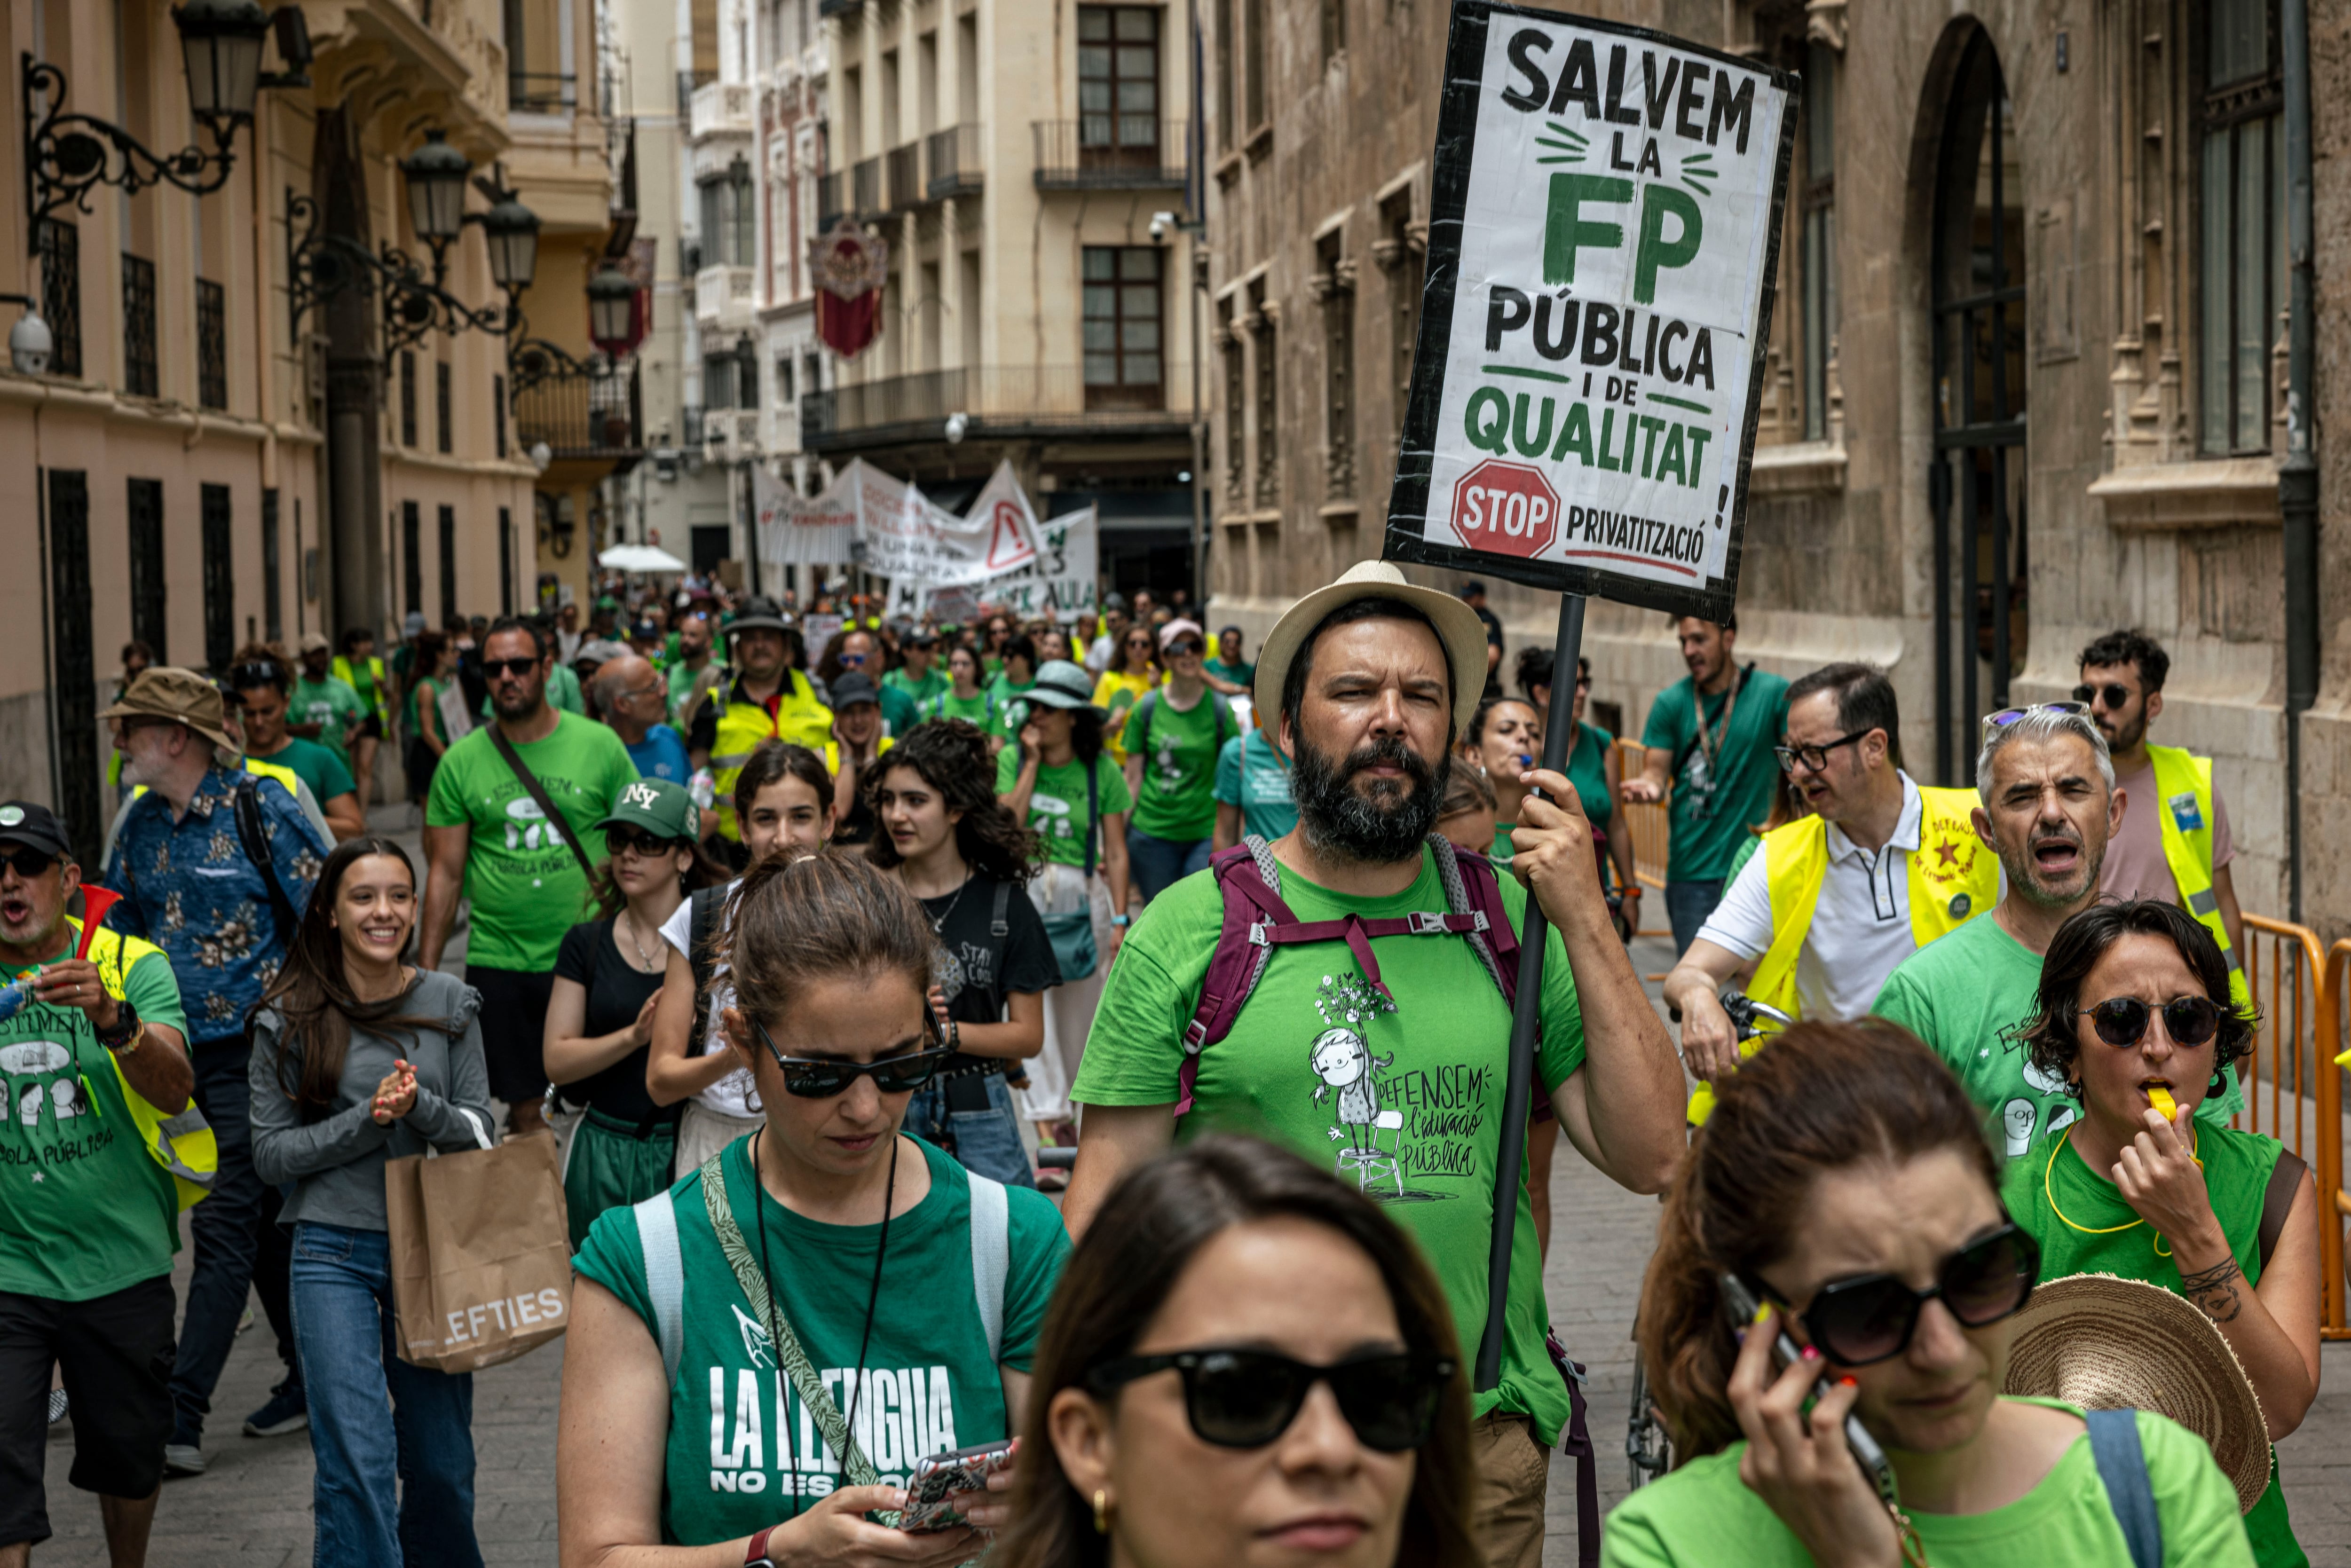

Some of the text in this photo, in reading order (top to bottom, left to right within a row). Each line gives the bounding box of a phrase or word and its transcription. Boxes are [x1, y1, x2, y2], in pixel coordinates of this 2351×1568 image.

[1500, 28, 1755, 156] SALVEM
[1611, 131, 1661, 178] LA
[1543, 172, 1703, 306] FP
[1485, 287, 1716, 392] PÚBLICA
[1582, 372, 1638, 407] I DE
[1464, 386, 1712, 490] QUALITAT
[1463, 486, 1549, 539] STOP
[1566, 505, 1706, 565] PRIVATITZACIÓ
[622, 783, 660, 810] NY
[960, 941, 993, 968] STAY
[1378, 1064, 1483, 1110] DEFENSEM
[444, 1288, 564, 1346] EFTIES
[709, 1366, 764, 1469] LA
[710, 1471, 834, 1497] NO ES
